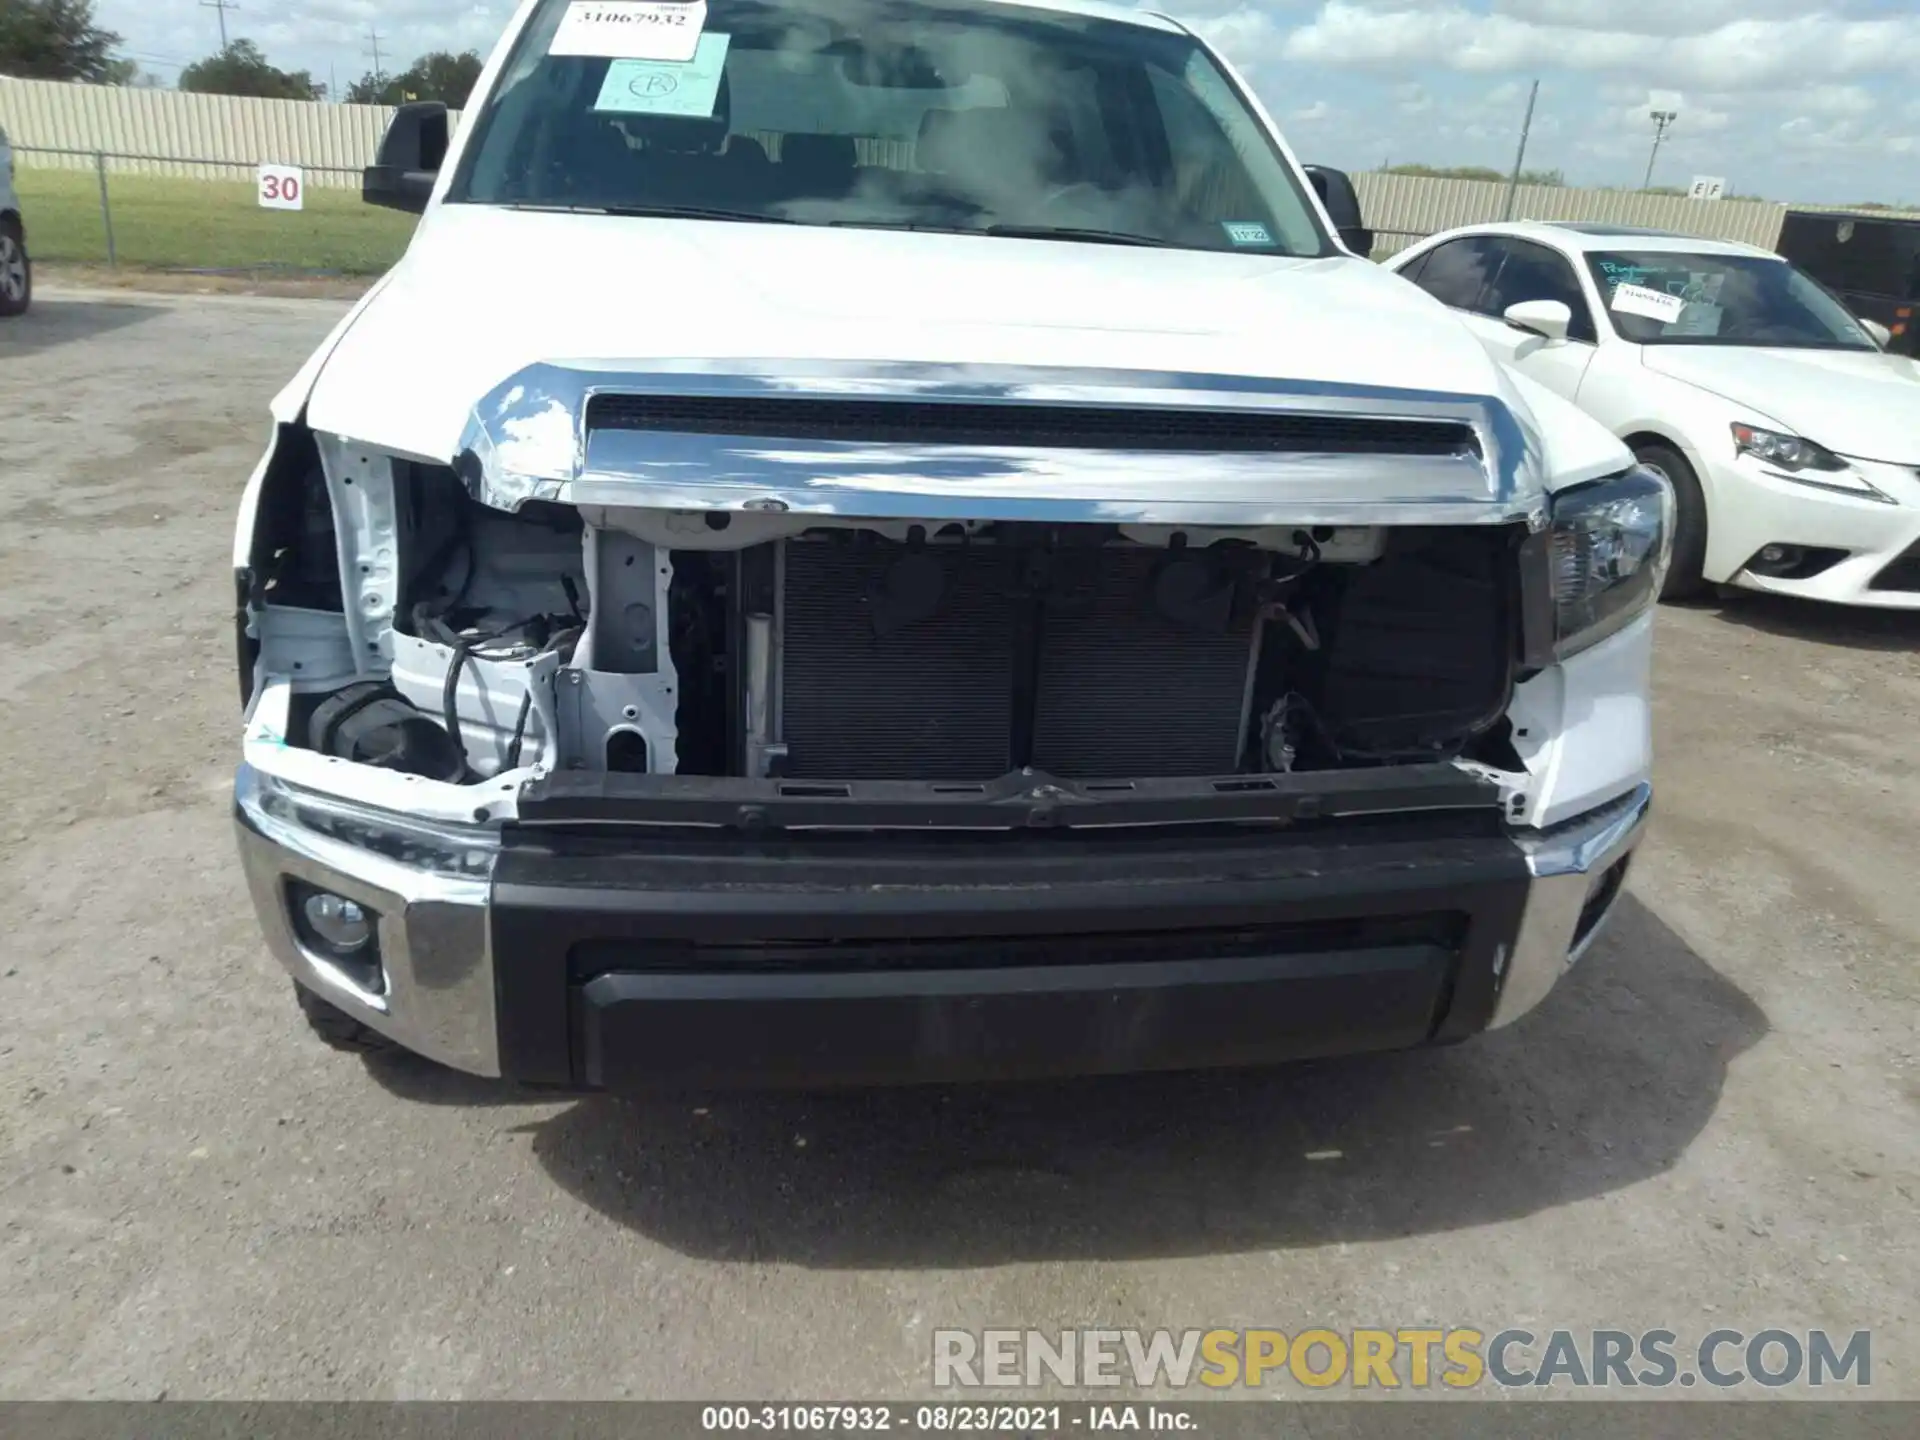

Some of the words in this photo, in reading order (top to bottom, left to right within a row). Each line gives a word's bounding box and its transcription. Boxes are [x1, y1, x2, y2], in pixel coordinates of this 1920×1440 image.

[577, 11, 686, 27] 31067932
[262, 174, 299, 202] 30
[1694, 182, 1705, 195] E
[1710, 183, 1721, 196] F
